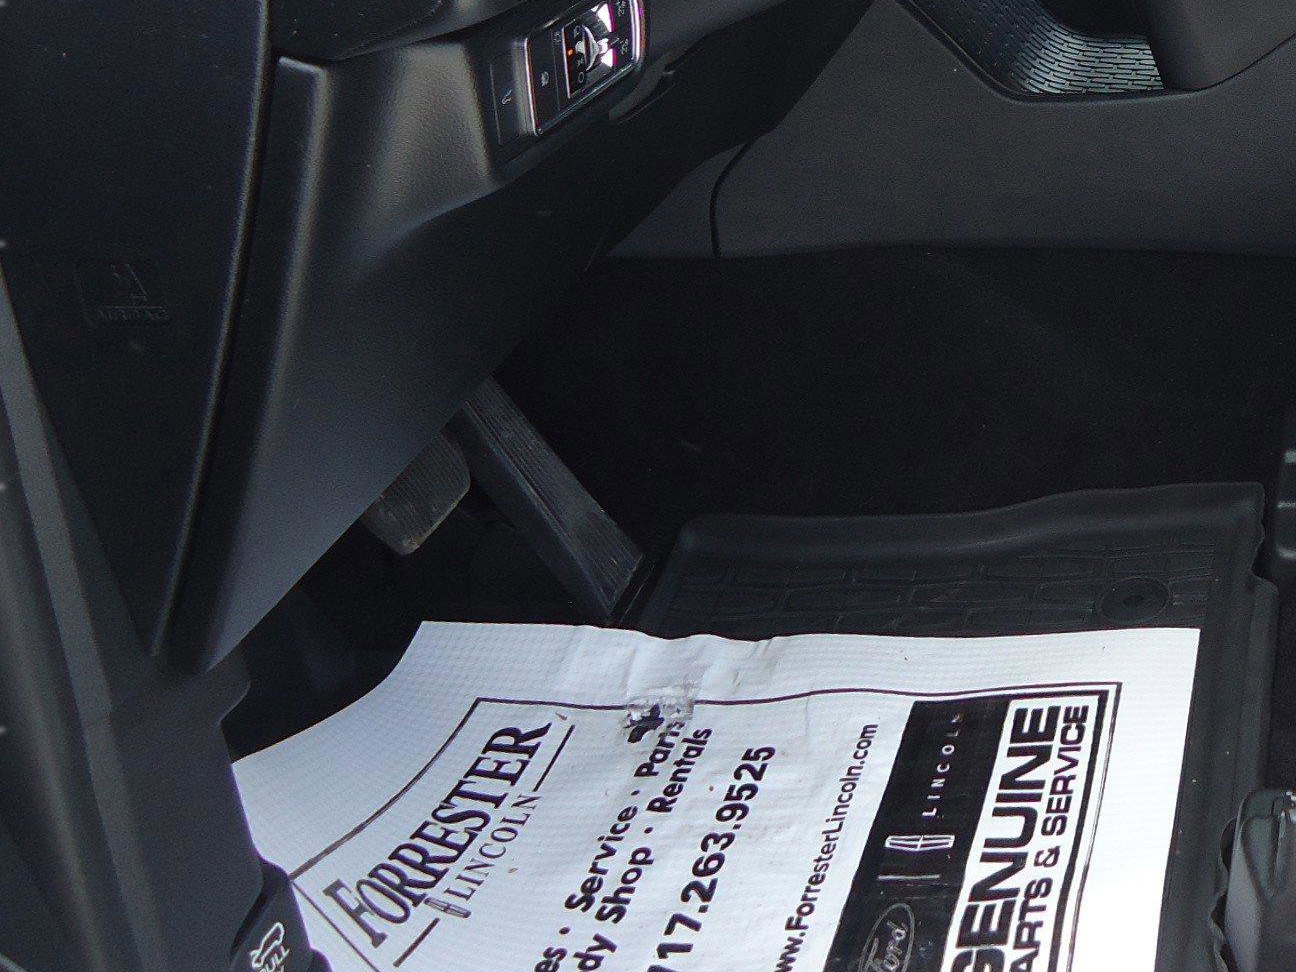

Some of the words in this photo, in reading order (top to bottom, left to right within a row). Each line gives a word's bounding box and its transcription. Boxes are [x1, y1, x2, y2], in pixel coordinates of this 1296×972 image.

[323, 723, 552, 948] FORRESTER
[595, 846, 655, 924] Shop
[646, 728, 713, 812] Rentals
[1040, 705, 1090, 836] SERVICE
[444, 794, 542, 901] LINCOLN
[564, 806, 639, 913] Service
[647, 746, 776, 972] 17.263.9525
[1033, 845, 1060, 868] &
